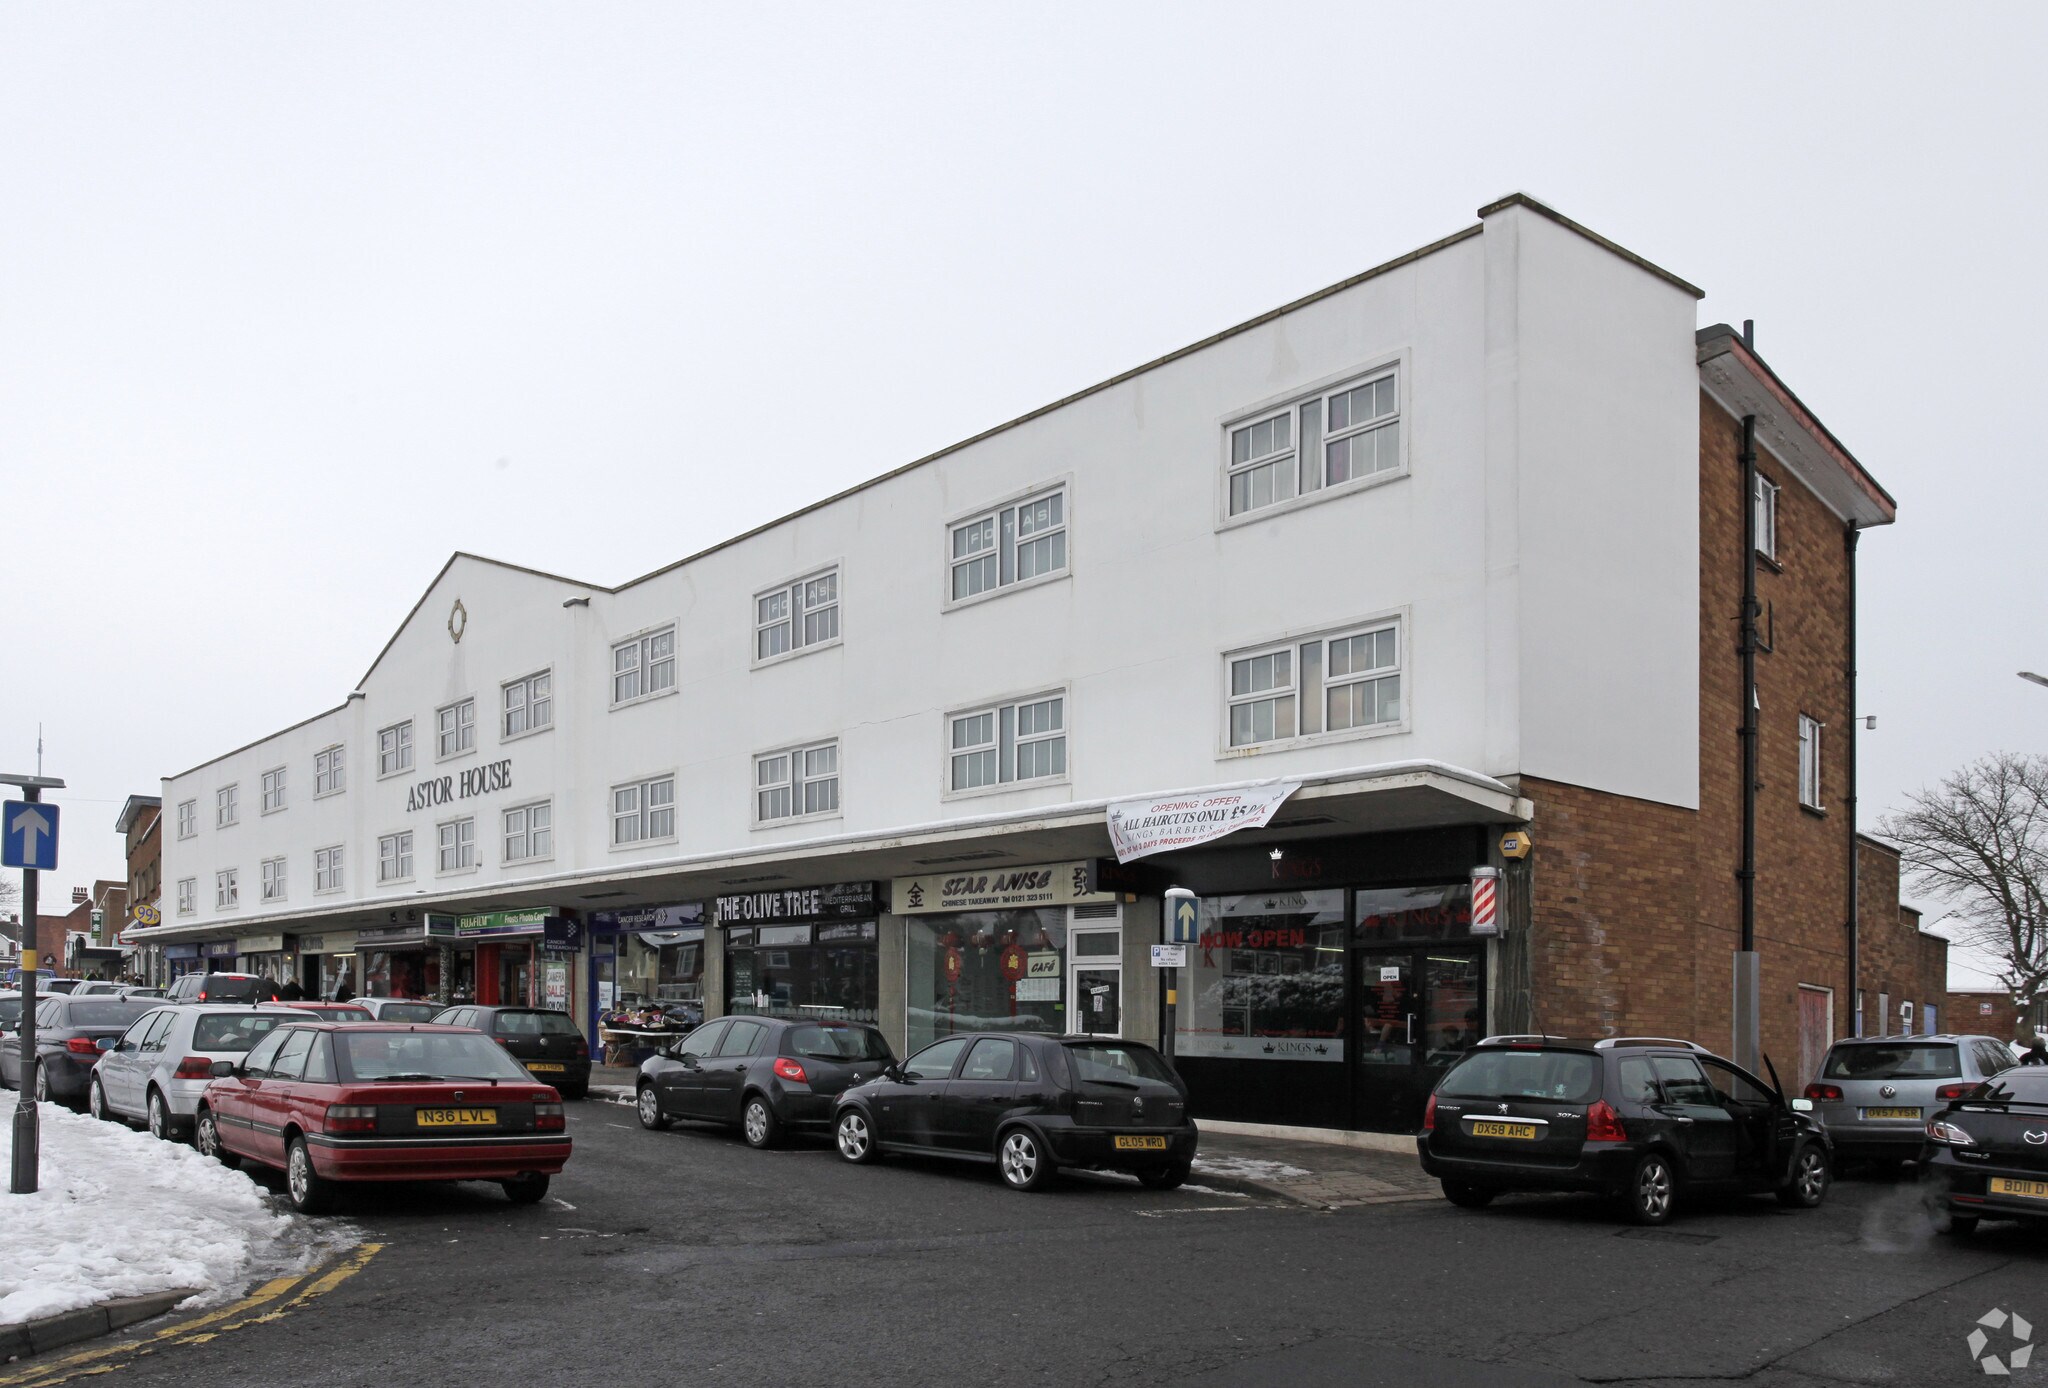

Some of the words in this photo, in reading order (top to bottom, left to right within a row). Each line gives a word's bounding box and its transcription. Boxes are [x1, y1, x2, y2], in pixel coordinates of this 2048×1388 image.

[406, 776, 453, 812] ASTOR
[459, 758, 511, 798] HOUSE
[1150, 800, 1198, 813] OPENING
[1202, 795, 1241, 807] OFFER
[1123, 819, 1140, 831] ALL
[1141, 810, 1197, 828] HAIRCUTS
[1197, 808, 1229, 822] ONLY
[1126, 829, 1154, 842] KINGS
[1159, 824, 1214, 836] BARBERS
[1143, 839, 1157, 849] DAYS
[1159, 834, 1196, 845] PROCEEDS
[1206, 828, 1225, 838] LOCAL
[1503, 840, 1518, 849] ADT
[941, 875, 988, 897] STAR
[991, 870, 1053, 893] ANISE
[823, 893, 872, 905] MEDITERRANEAN
[907, 882, 925, 908] 金
[941, 898, 967, 907] CHINESE
[968, 896, 999, 906] TAKEAWAY
[1011, 894, 1025, 903] 0121
[1026, 894, 1038, 902] 323
[1038, 892, 1053, 901] 5111
[716, 896, 740, 921] THE
[743, 892, 780, 919] OLIVE
[783, 889, 819, 917] TREE
[839, 904, 857, 913] GRILL
[519, 913, 533, 922] Photo
[533, 911, 550, 921] Cent
[617, 915, 634, 924] CANCER
[634, 914, 655, 923] RESEARCH
[1200, 929, 1243, 950] NOW
[1247, 928, 1305, 949] OPEN
[546, 985, 565, 997] SALE
[1278, 1042, 1312, 1053] KINGS
[424, 1110, 456, 1123] N36
[460, 1110, 490, 1122] LVL
[1477, 1123, 1506, 1135] DX58
[1508, 1125, 1531, 1137] AHC
[2004, 1181, 2032, 1193] BD11
